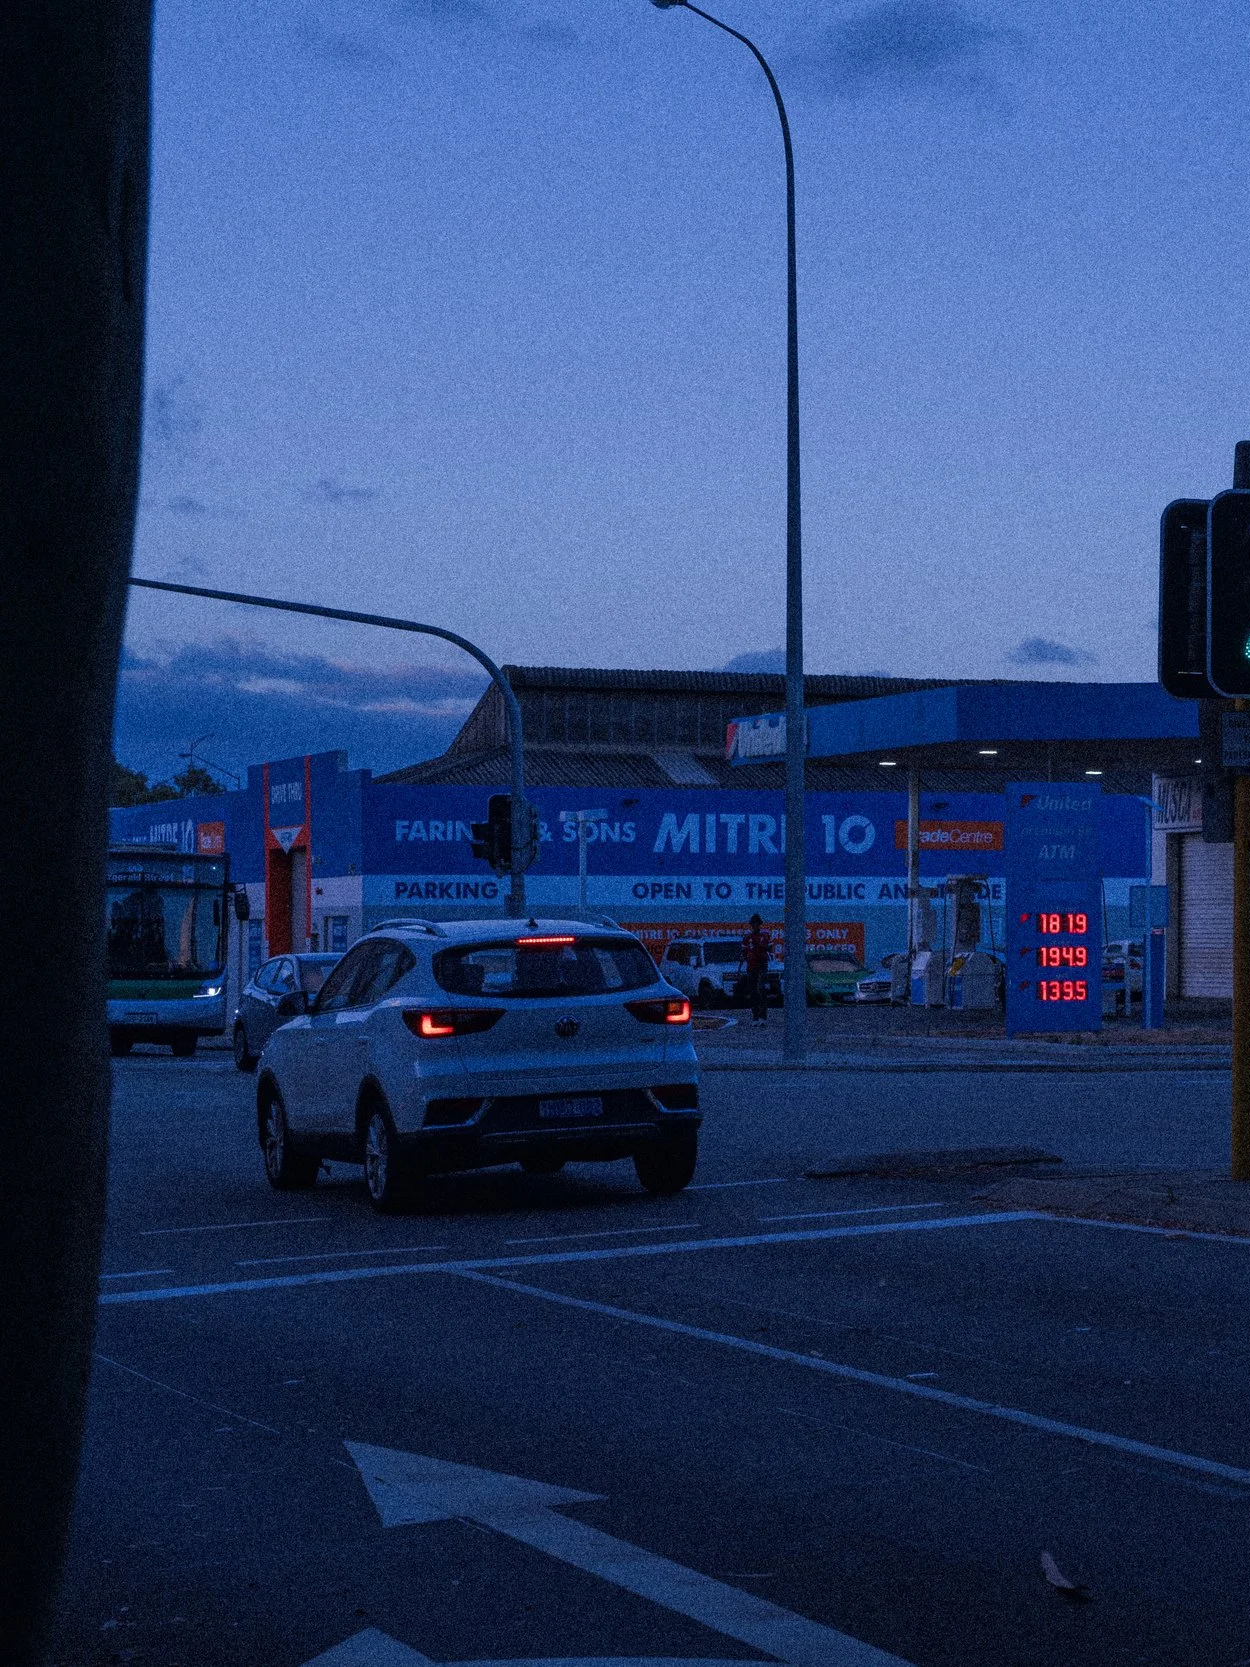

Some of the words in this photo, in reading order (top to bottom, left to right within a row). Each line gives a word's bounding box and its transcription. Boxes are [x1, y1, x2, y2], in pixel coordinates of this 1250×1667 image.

[1037, 794, 1093, 811] United
[562, 821, 637, 843] SONS
[821, 814, 876, 855] 10
[919, 828, 994, 844] adeCentre
[1039, 844, 1077, 859] ATM
[395, 881, 499, 900] PARKING
[632, 882, 692, 901] OPEN
[703, 882, 732, 900] TO
[745, 883, 783, 900] THE
[804, 882, 866, 900] UBLIC
[878, 883, 909, 899] AN
[817, 928, 849, 939] ONLY
